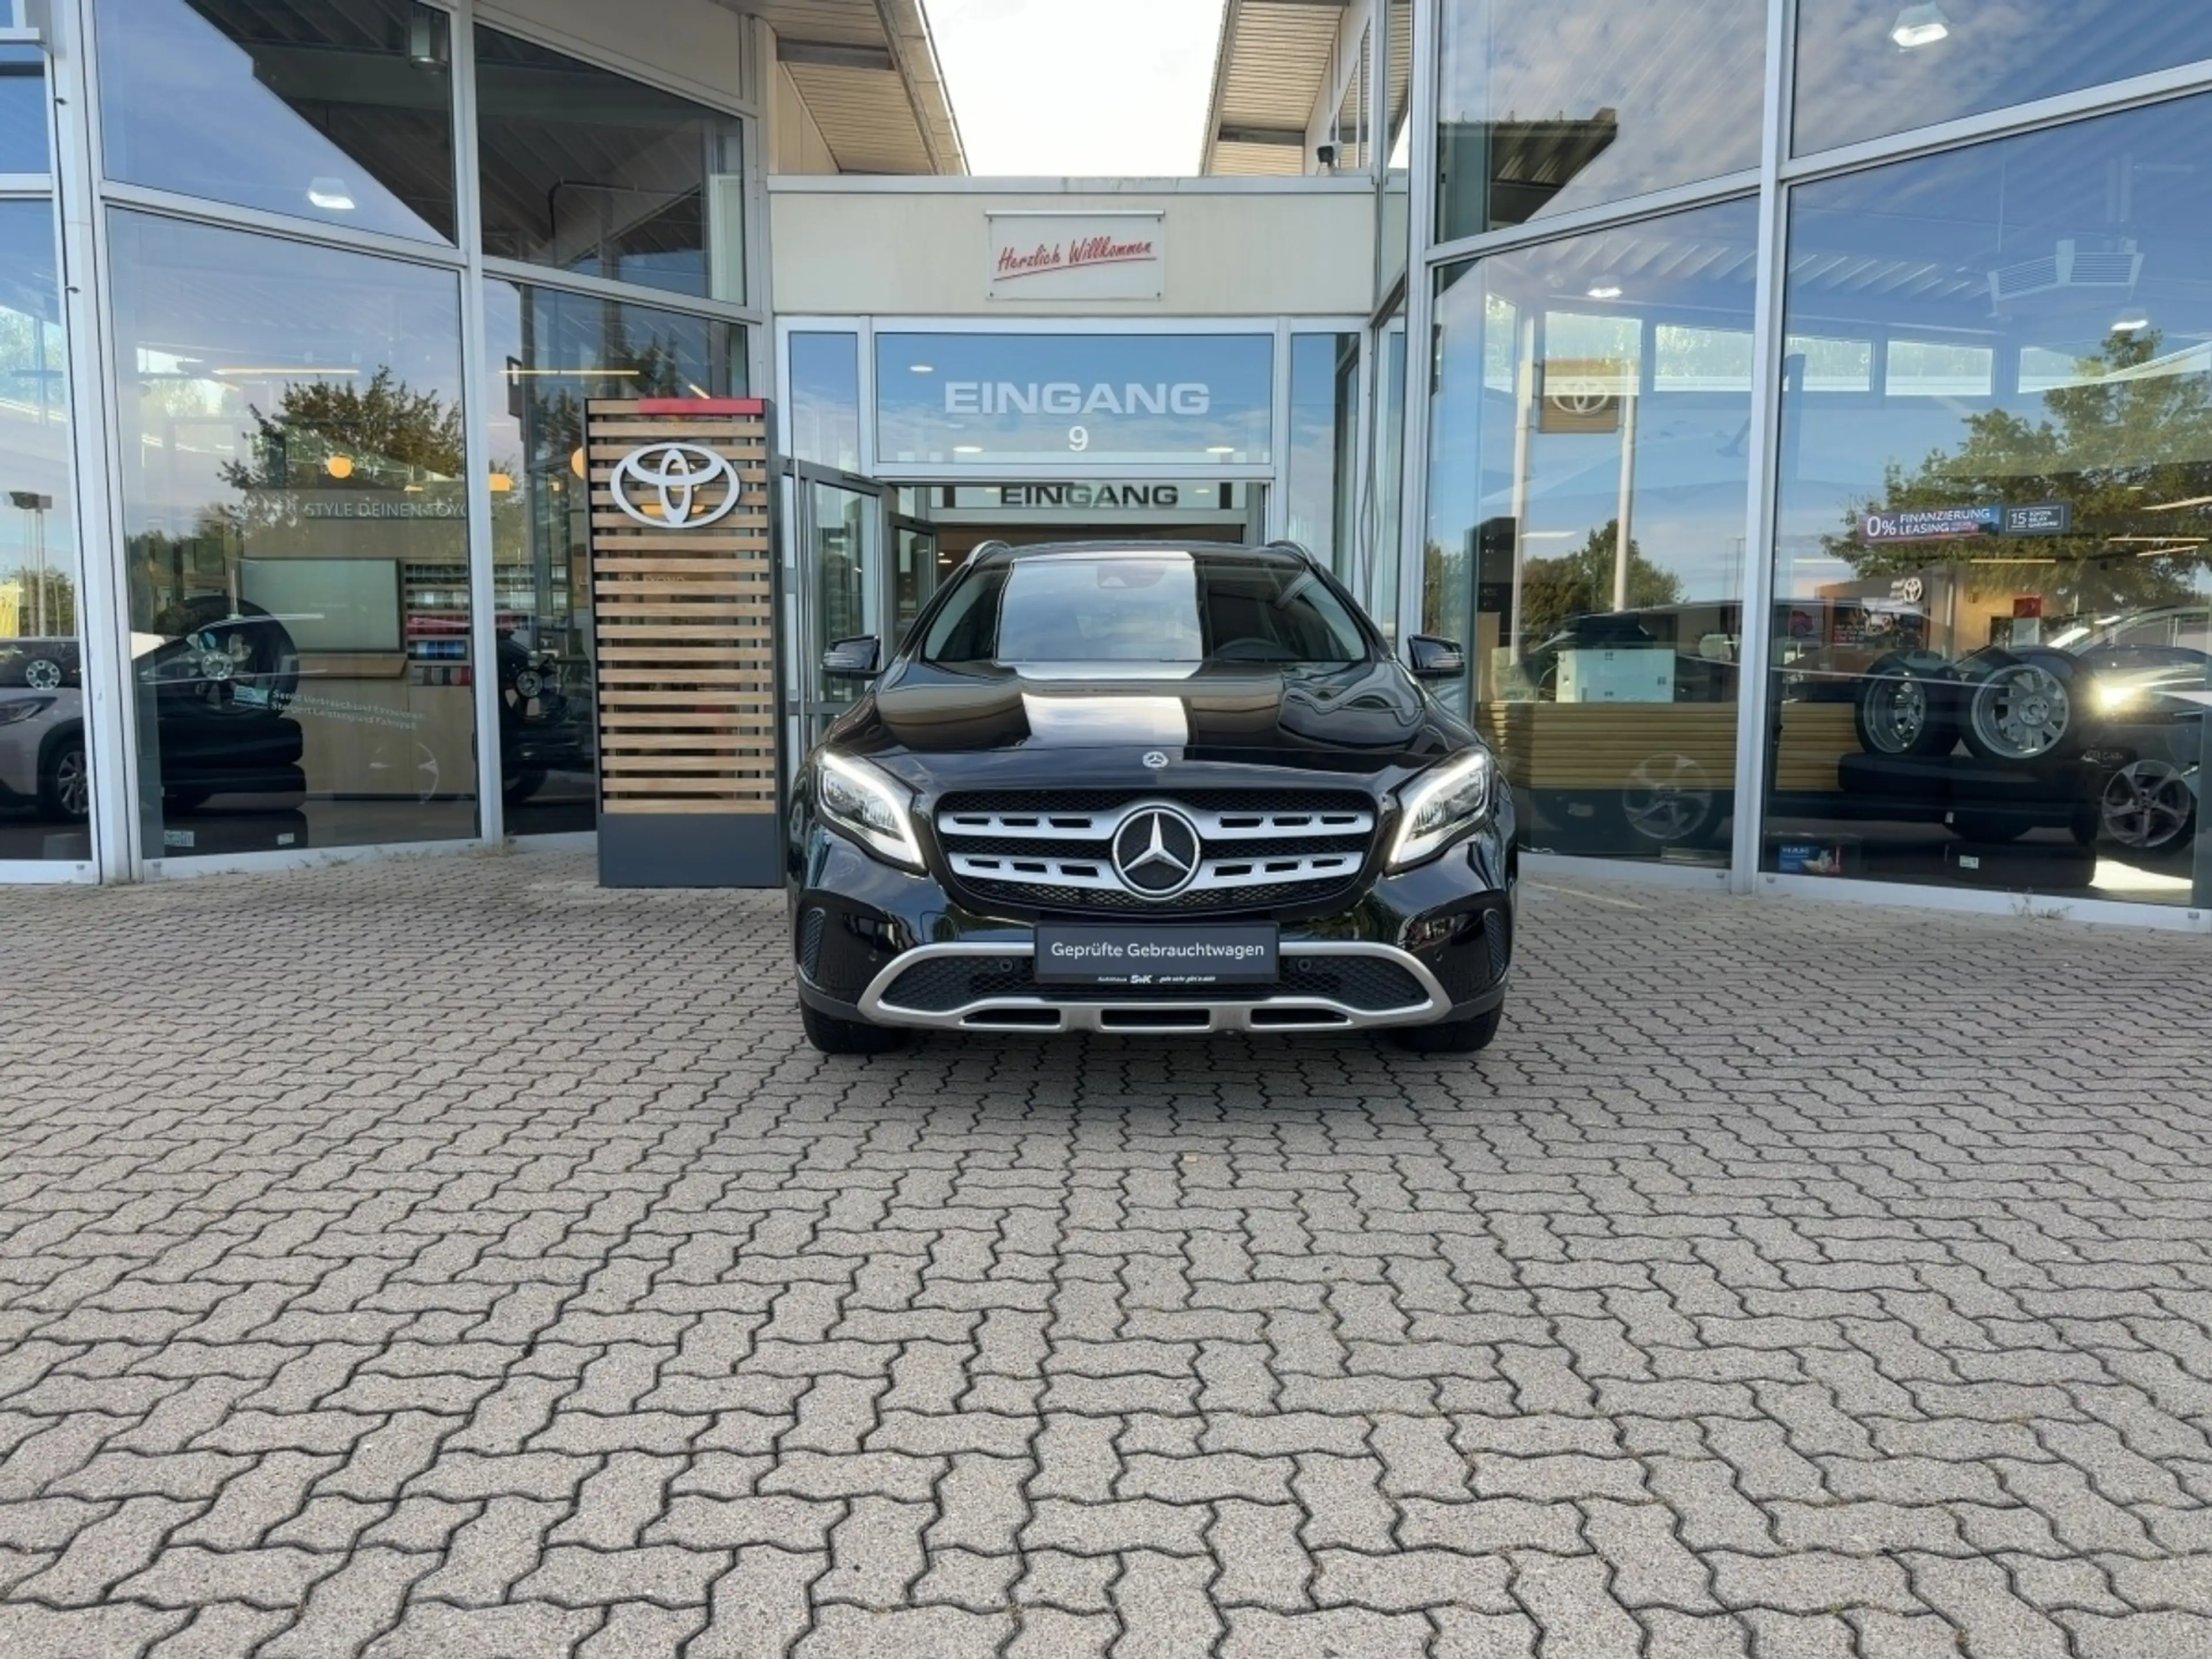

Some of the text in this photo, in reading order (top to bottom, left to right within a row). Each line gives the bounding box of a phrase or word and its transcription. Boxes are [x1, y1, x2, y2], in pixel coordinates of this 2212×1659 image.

[998, 236, 1153, 272] Herzlich Willkommen
[945, 381, 1210, 414] EINGANG
[1069, 425, 1089, 452] 9
[1001, 484, 1179, 506] EINGANG
[305, 502, 353, 517] STYLE
[358, 502, 422, 518] DEINEN
[1900, 508, 1991, 523] FINANZIERUNG
[2010, 512, 2027, 525] 15
[1866, 516, 1897, 537] 0%
[1900, 522, 1950, 535] LEASING
[1051, 941, 1264, 960] Geprüfte Gebrauchtwagen
